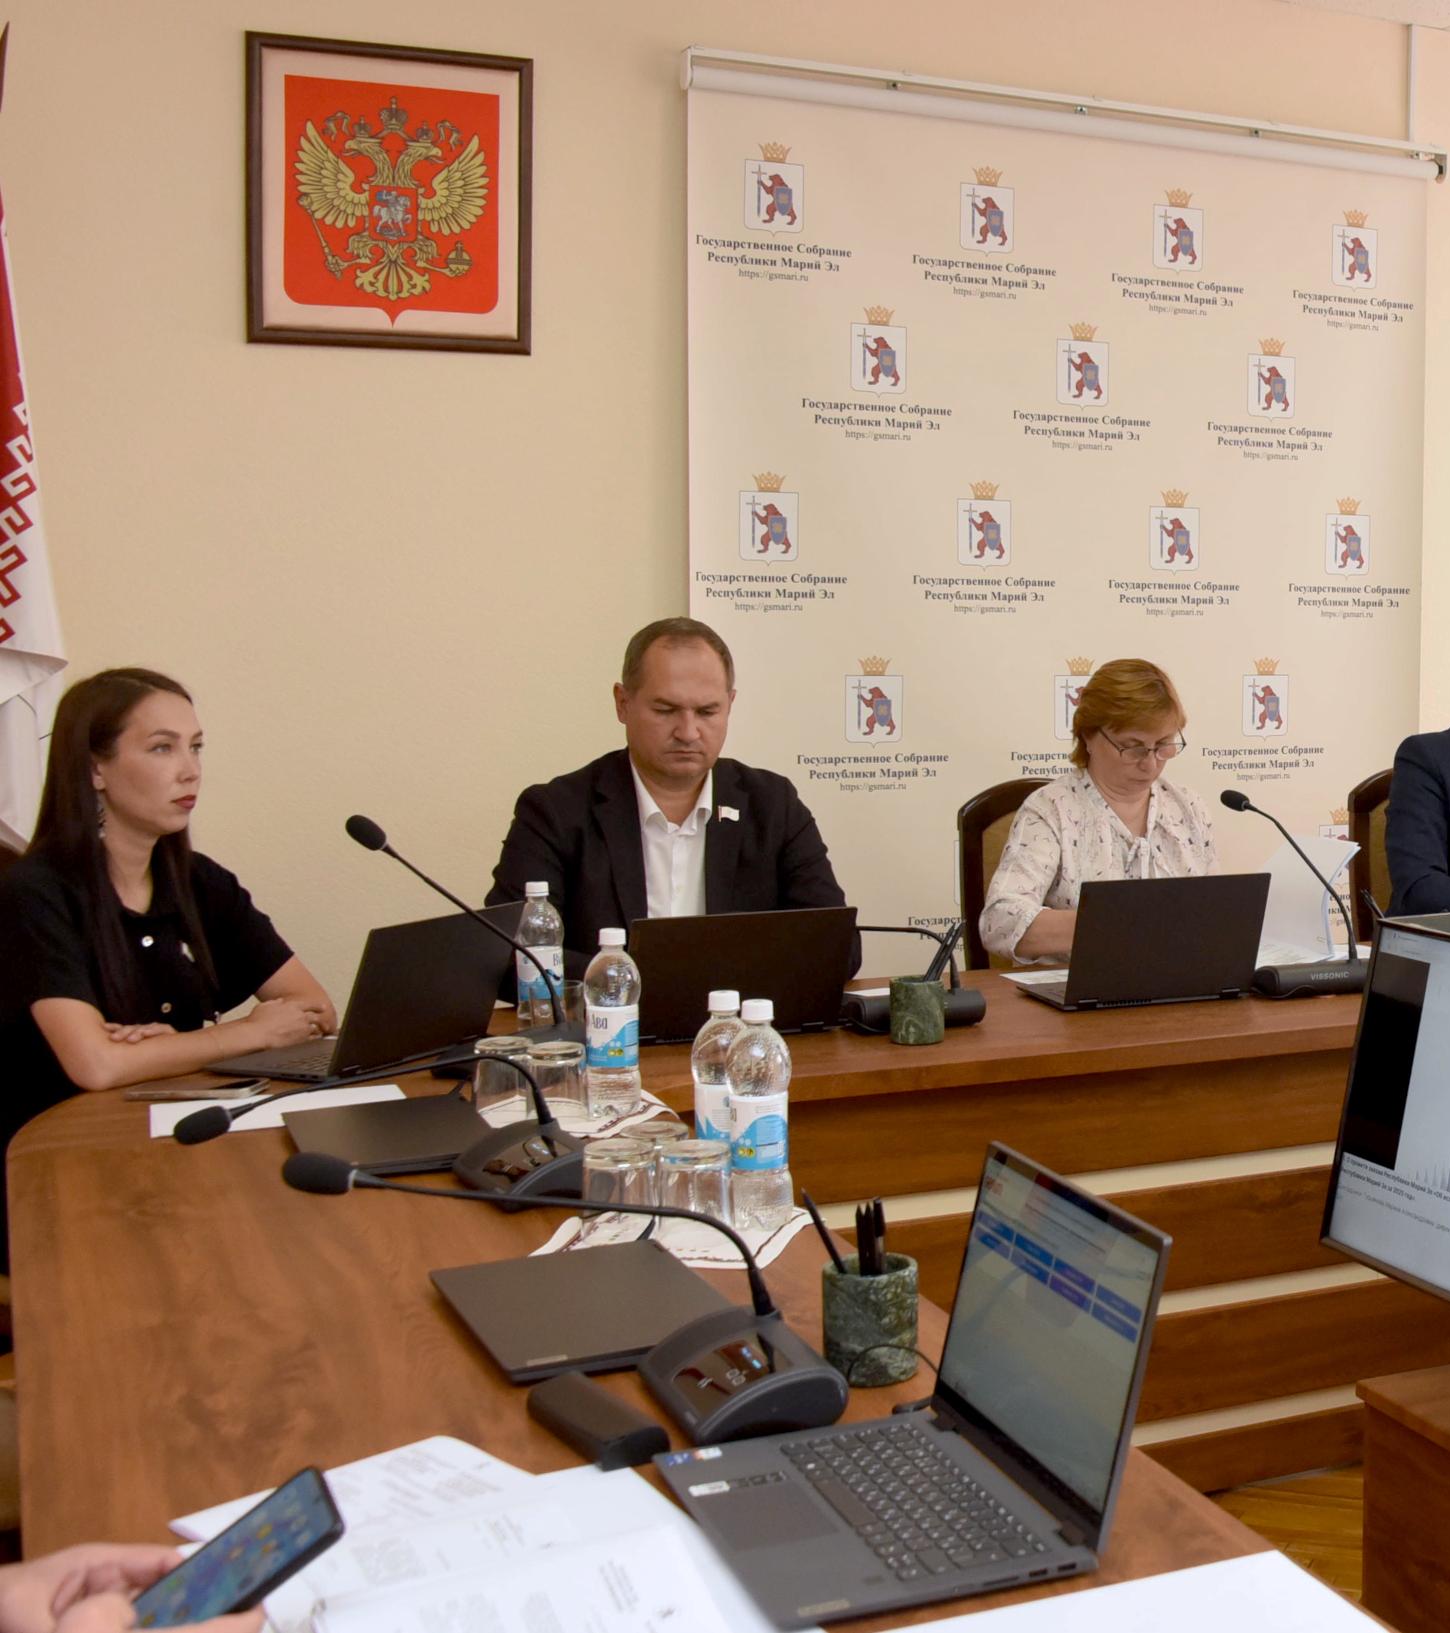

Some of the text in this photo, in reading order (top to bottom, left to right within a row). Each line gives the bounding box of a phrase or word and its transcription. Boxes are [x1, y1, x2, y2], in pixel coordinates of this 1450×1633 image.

[696, 235, 852, 258] Государственное Собрание
[708, 252, 839, 272] Республики Марий Эл
[913, 254, 1056, 276] Государственное Собрание
[924, 270, 1045, 290] Республики Марий Эл
[1112, 273, 1244, 294] Государственное Собрание
[1122, 288, 1233, 306] Республики Марий Эл
[1293, 290, 1413, 310] Государственное Собрание
[1303, 304, 1403, 322] Республики Марий Эл
[802, 398, 952, 417] Государственное Собрание
[815, 414, 940, 431] Республики Марий Эл
[1013, 410, 1150, 428] Государственное Собрание
[1024, 425, 1139, 441] Республики Марий Эл
[1208, 422, 1332, 439] Государственное Собрание
[1218, 436, 1322, 452] Республики Марий Эл
[696, 572, 847, 586] Государственное Собрание
[913, 575, 1055, 589] Государственное Собрание
[1109, 579, 1240, 593] Государственное Собрание
[706, 588, 834, 601] Республики Марий Эл
[925, 590, 1044, 603] Республики Марий Эл
[1289, 583, 1410, 596] Государственное Собрание
[1120, 594, 1229, 607] Республики Марий Эл
[1298, 597, 1399, 609] Республики Марий Эл
[1011, 752, 1072, 762] Государств
[1202, 746, 1324, 758] Государственное Собрание
[797, 753, 949, 766] Государственное Собрание
[1212, 759, 1314, 771] Республики Марий Эл
[810, 768, 936, 781] Республики Марий Эл
[1022, 765, 1072, 777] Республи
[1310, 971, 1350, 980] VISSONIC
